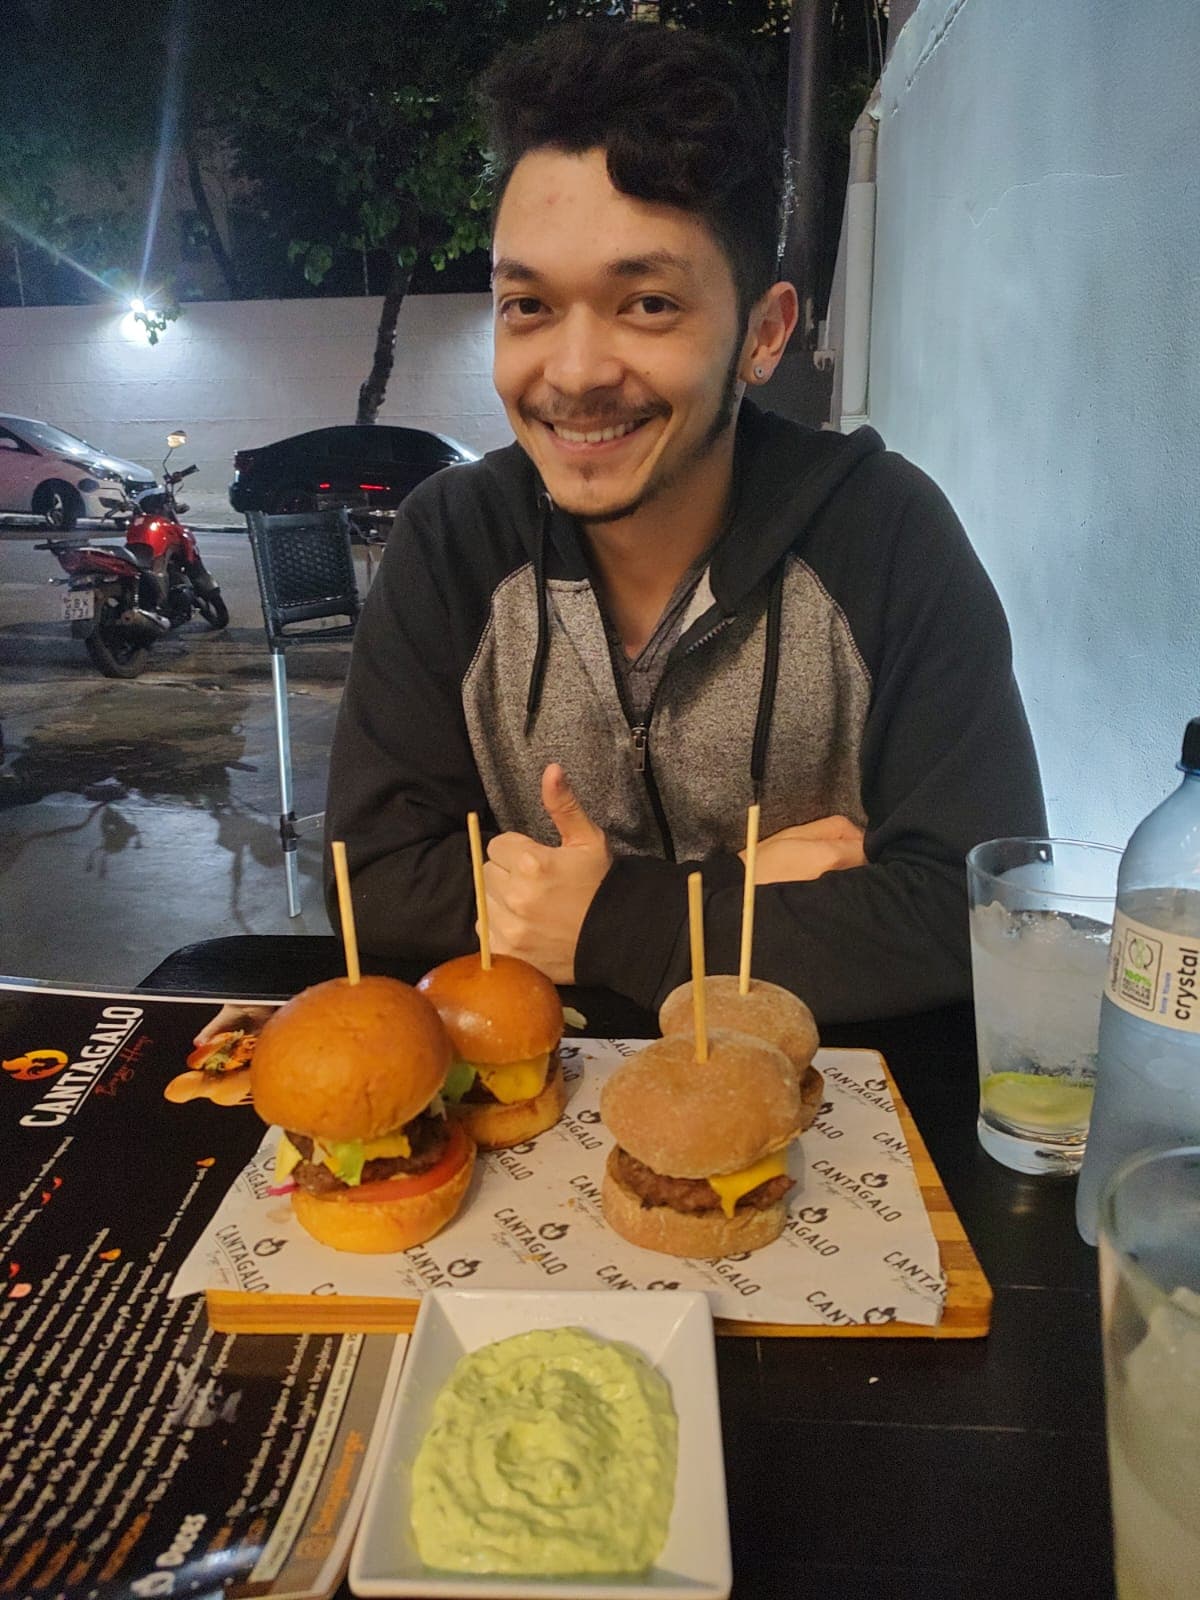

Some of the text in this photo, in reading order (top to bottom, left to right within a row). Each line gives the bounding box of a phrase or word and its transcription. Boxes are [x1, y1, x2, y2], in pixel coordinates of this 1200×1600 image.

[1174, 947, 1200, 1021] crystal
[19, 1006, 144, 1127] CANTAGALO
[822, 1066, 898, 1113] CANTAGALO
[561, 1113, 604, 1151] TAGALO
[243, 1162, 272, 1200] TAGALO
[494, 1151, 534, 1181] AGALO
[811, 1159, 902, 1223] CANTAGALO
[215, 1224, 270, 1293] CANTAGALO
[494, 1207, 569, 1276] CANTAGALO
[784, 1215, 841, 1258] AGALO
[403, 1244, 453, 1288] CANTA
[706, 1254, 762, 1298] AGALO
[883, 1251, 948, 1297] CANTA
